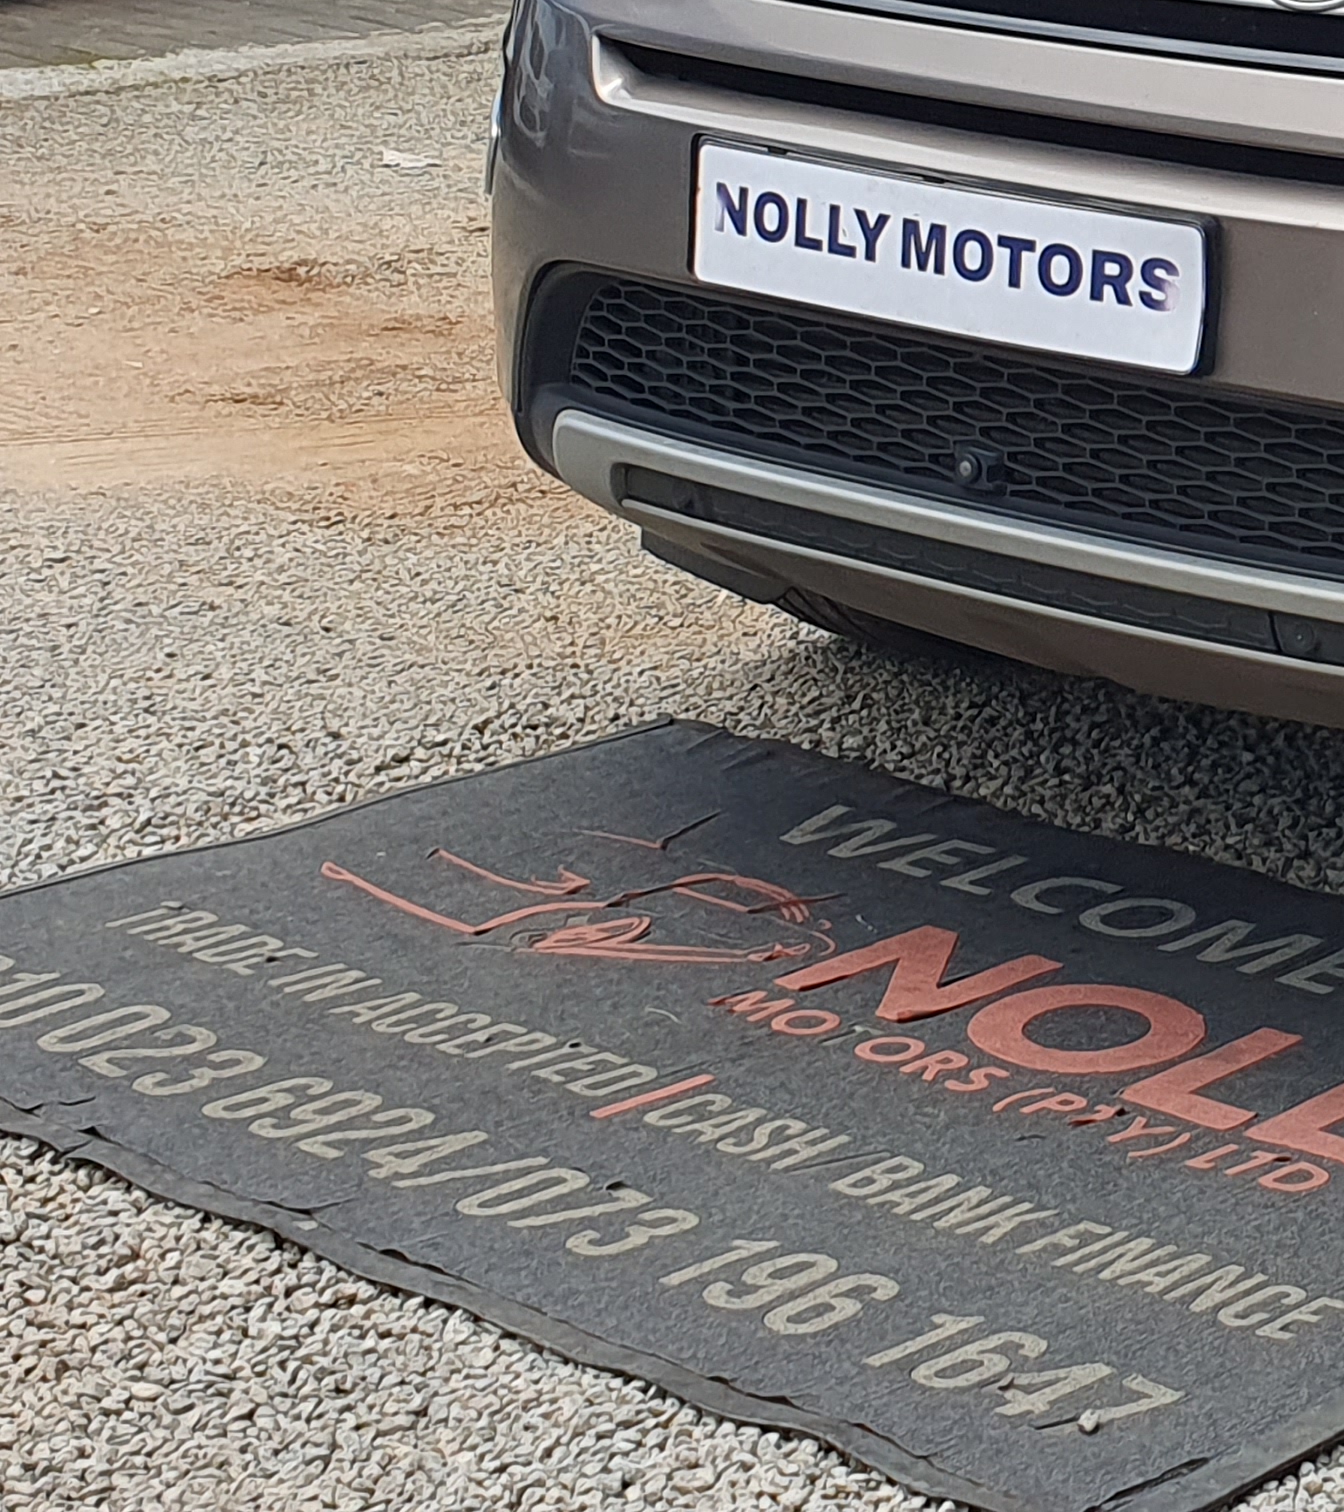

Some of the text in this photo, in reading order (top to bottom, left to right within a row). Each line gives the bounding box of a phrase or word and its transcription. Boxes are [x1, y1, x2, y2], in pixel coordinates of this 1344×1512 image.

[714, 181, 1180, 312] NOLLY MOTORS
[105, 900, 319, 976] TRADE
[267, 963, 383, 1002] IN
[708, 990, 1011, 1092] MOTORS
[1185, 1143, 1330, 1192] LTD
[36, 1004, 268, 1096] 023
[658, 1238, 901, 1336] 196
[862, 1313, 1187, 1431] 1647
